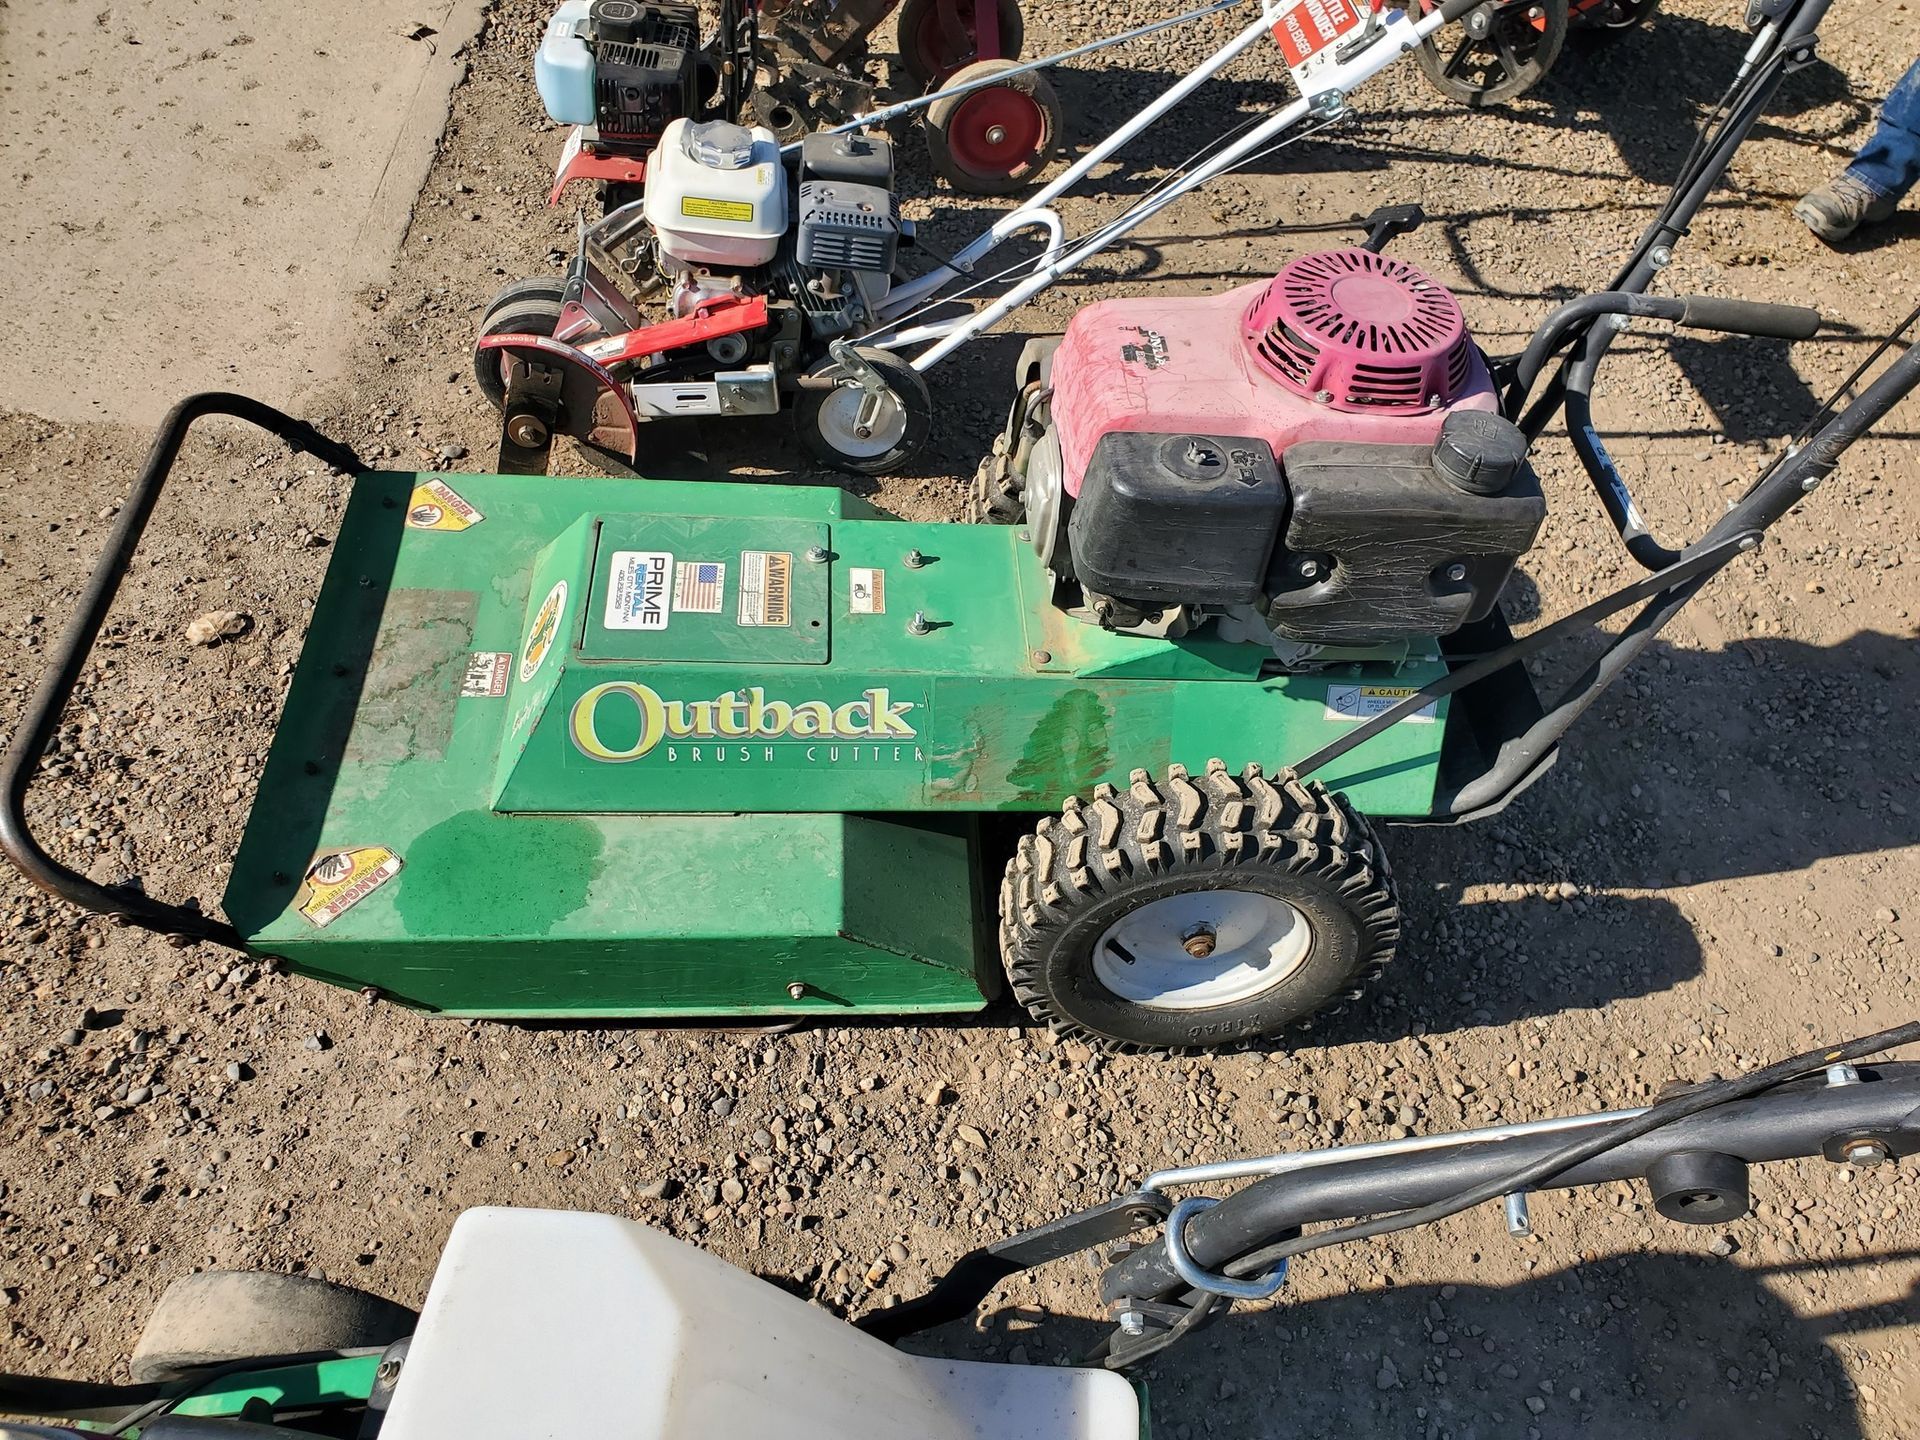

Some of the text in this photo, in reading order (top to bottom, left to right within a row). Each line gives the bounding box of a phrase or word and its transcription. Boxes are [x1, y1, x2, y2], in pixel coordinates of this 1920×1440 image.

[1283, 13, 1312, 58] PRO EDGER
[434, 486, 473, 517] DANGER
[631, 563, 647, 617] RENTAL
[643, 557, 665, 625] PRIME
[716, 598, 721, 606] IN
[767, 569, 785, 622] WARNING
[873, 580, 882, 611] WARNING
[622, 591, 632, 624] MONTANA
[493, 663, 506, 694] DANGER
[1379, 688, 1420, 696] CAUTI
[569, 681, 917, 763] Outback
[668, 746, 923, 762] BRUSH CUTTER
[351, 866, 373, 881] HANDS
[373, 854, 387, 867] KEEP
[324, 866, 390, 914] DANGER
[327, 887, 341, 900] FEET
